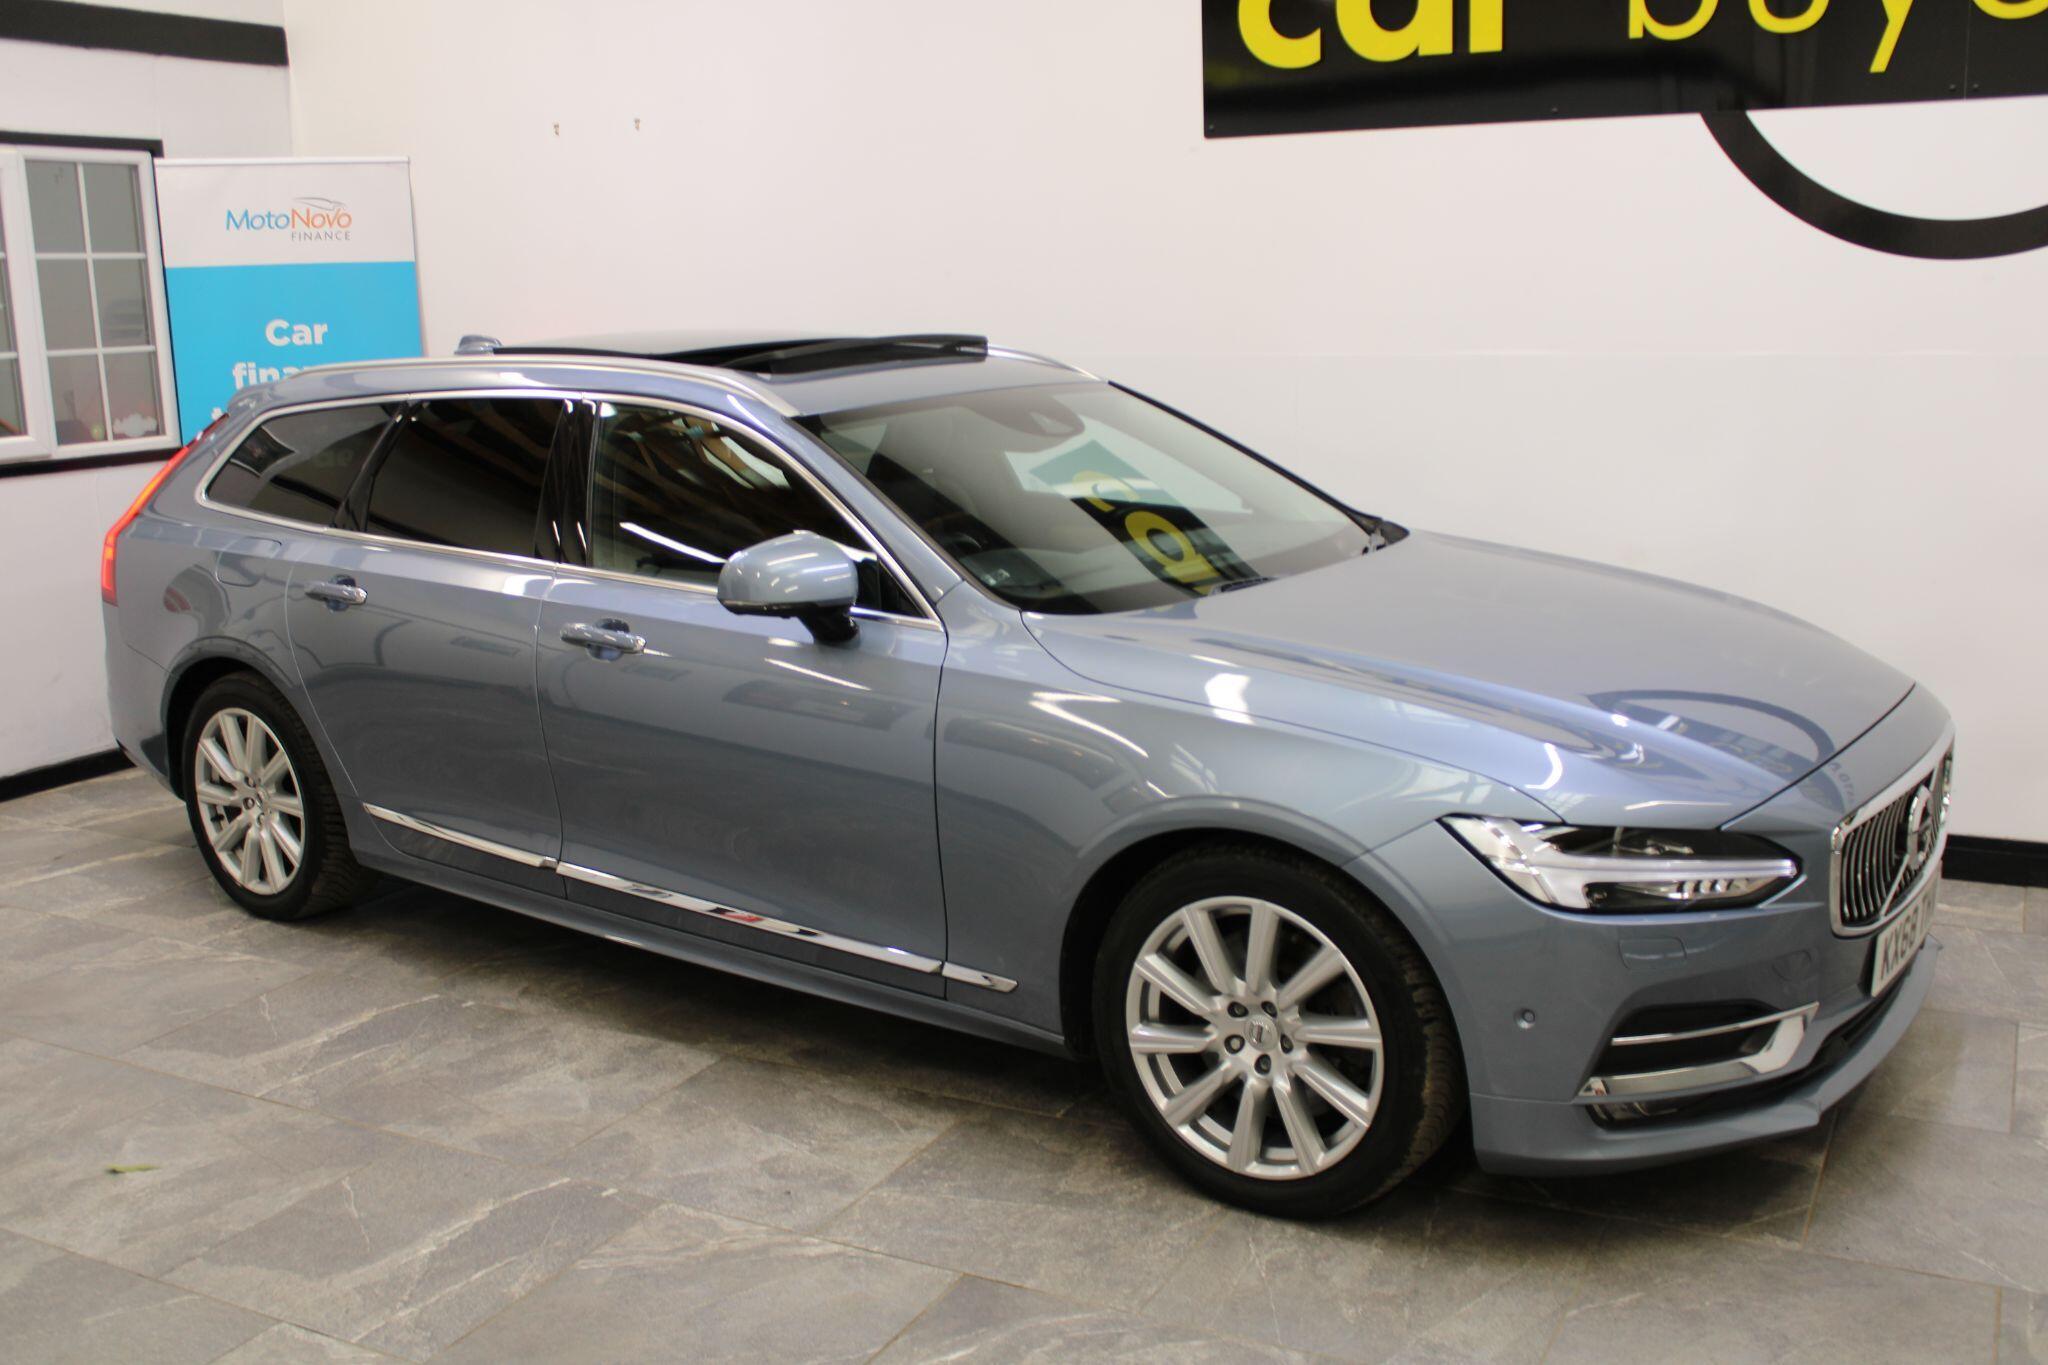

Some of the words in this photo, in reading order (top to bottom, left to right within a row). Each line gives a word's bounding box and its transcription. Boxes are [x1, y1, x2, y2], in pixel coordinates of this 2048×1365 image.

[226, 208, 352, 231] MotoNovo
[291, 231, 351, 241] FINANCE
[265, 319, 328, 347] Car
